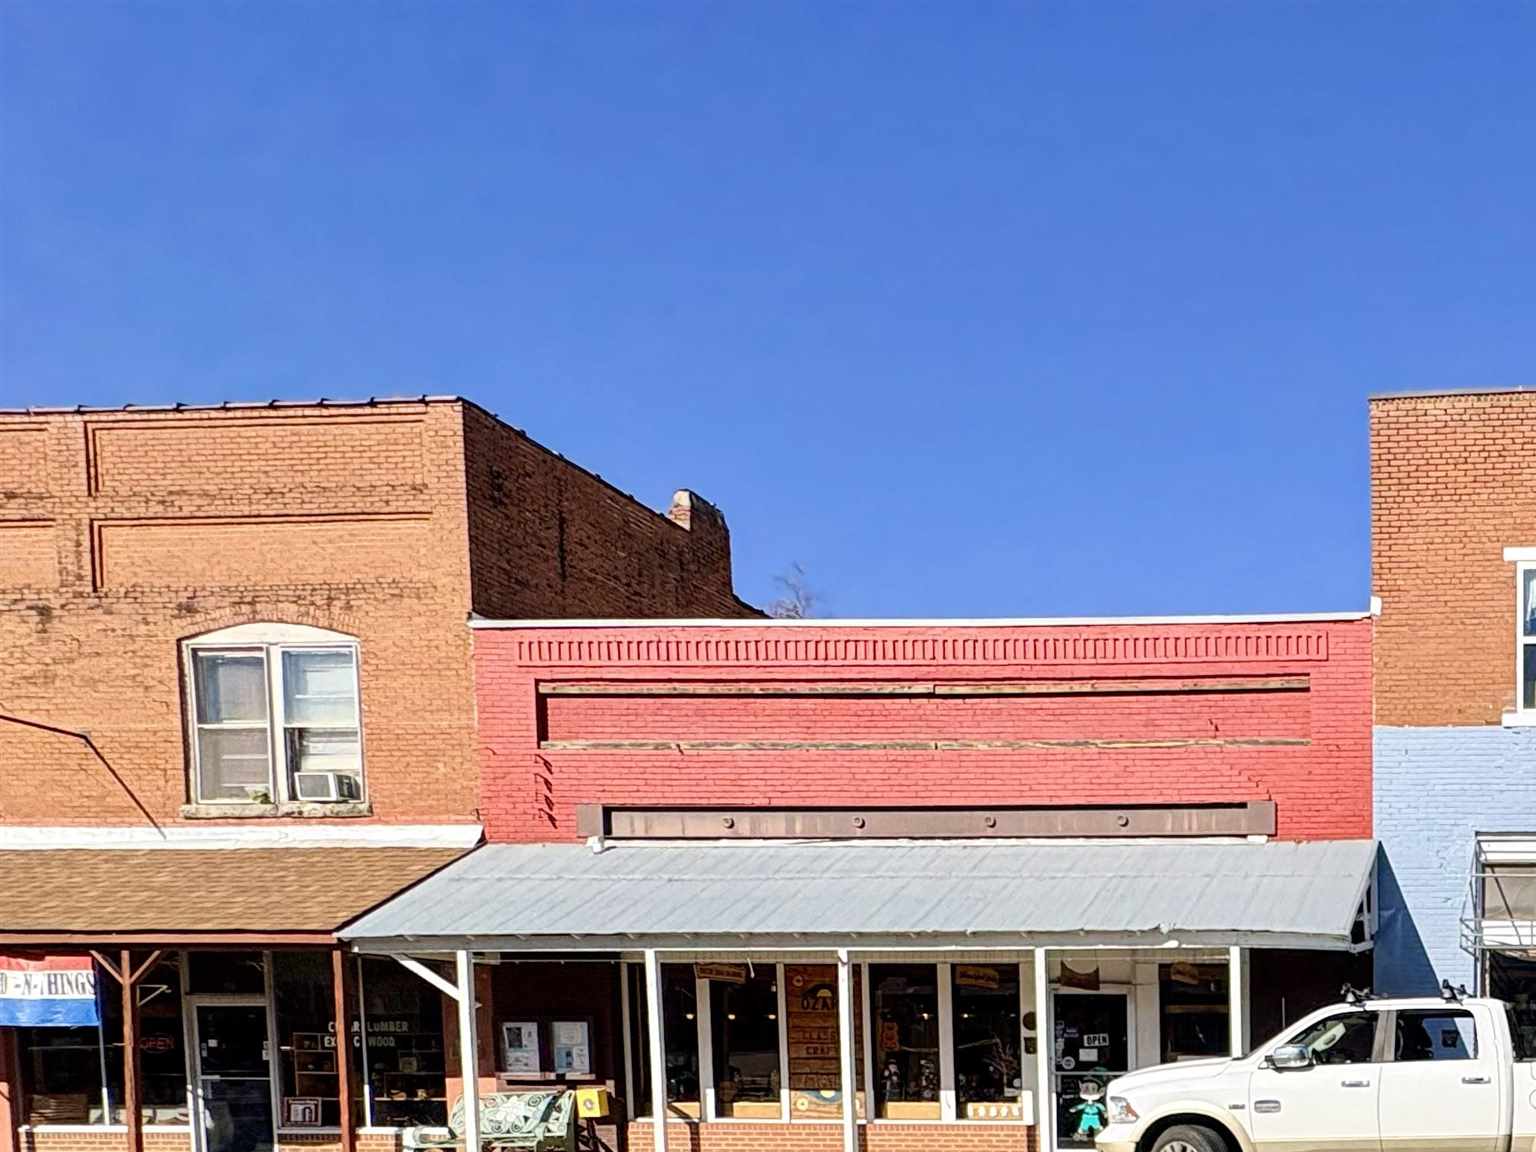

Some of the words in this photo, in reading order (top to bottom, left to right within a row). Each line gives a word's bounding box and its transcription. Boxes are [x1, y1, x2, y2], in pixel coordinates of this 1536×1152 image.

[366, 1021, 409, 1033] LUMBER
[367, 1036, 396, 1048] WOOD
[1086, 1034, 1107, 1046] OPEN
